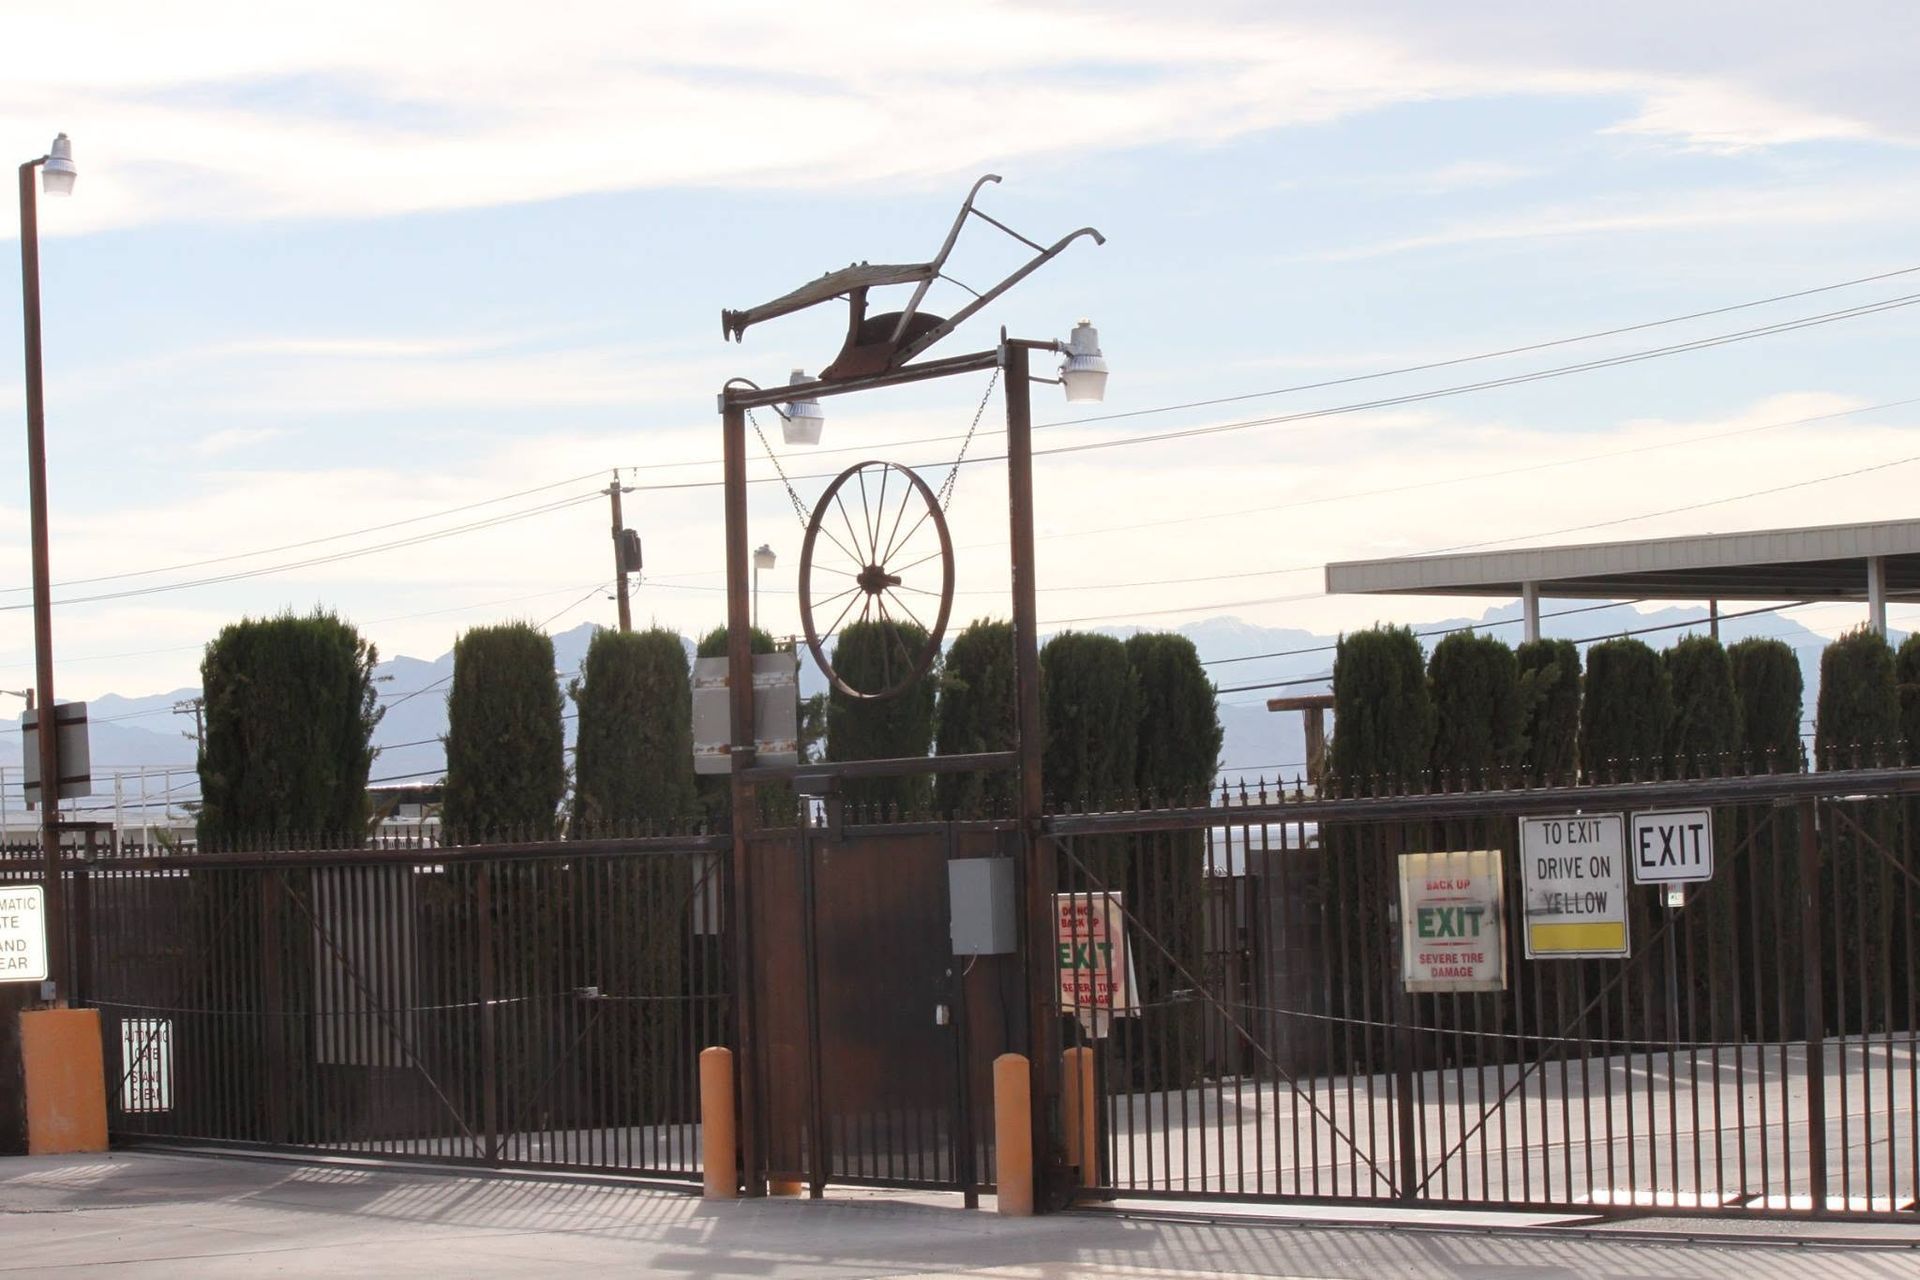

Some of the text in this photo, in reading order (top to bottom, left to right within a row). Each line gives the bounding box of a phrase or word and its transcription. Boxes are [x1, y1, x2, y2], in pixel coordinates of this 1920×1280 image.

[1543, 821, 1601, 845] TO EXIT
[1639, 823, 1704, 867] EXIT
[1538, 856, 1611, 879] DRIVE ON
[1426, 880, 1470, 890] BACK UP
[1543, 892, 1608, 915] YELLOW
[1417, 907, 1484, 938] EXIT
[1419, 953, 1484, 964] SEVERE TIRE
[1431, 967, 1473, 977] DAMAGE
